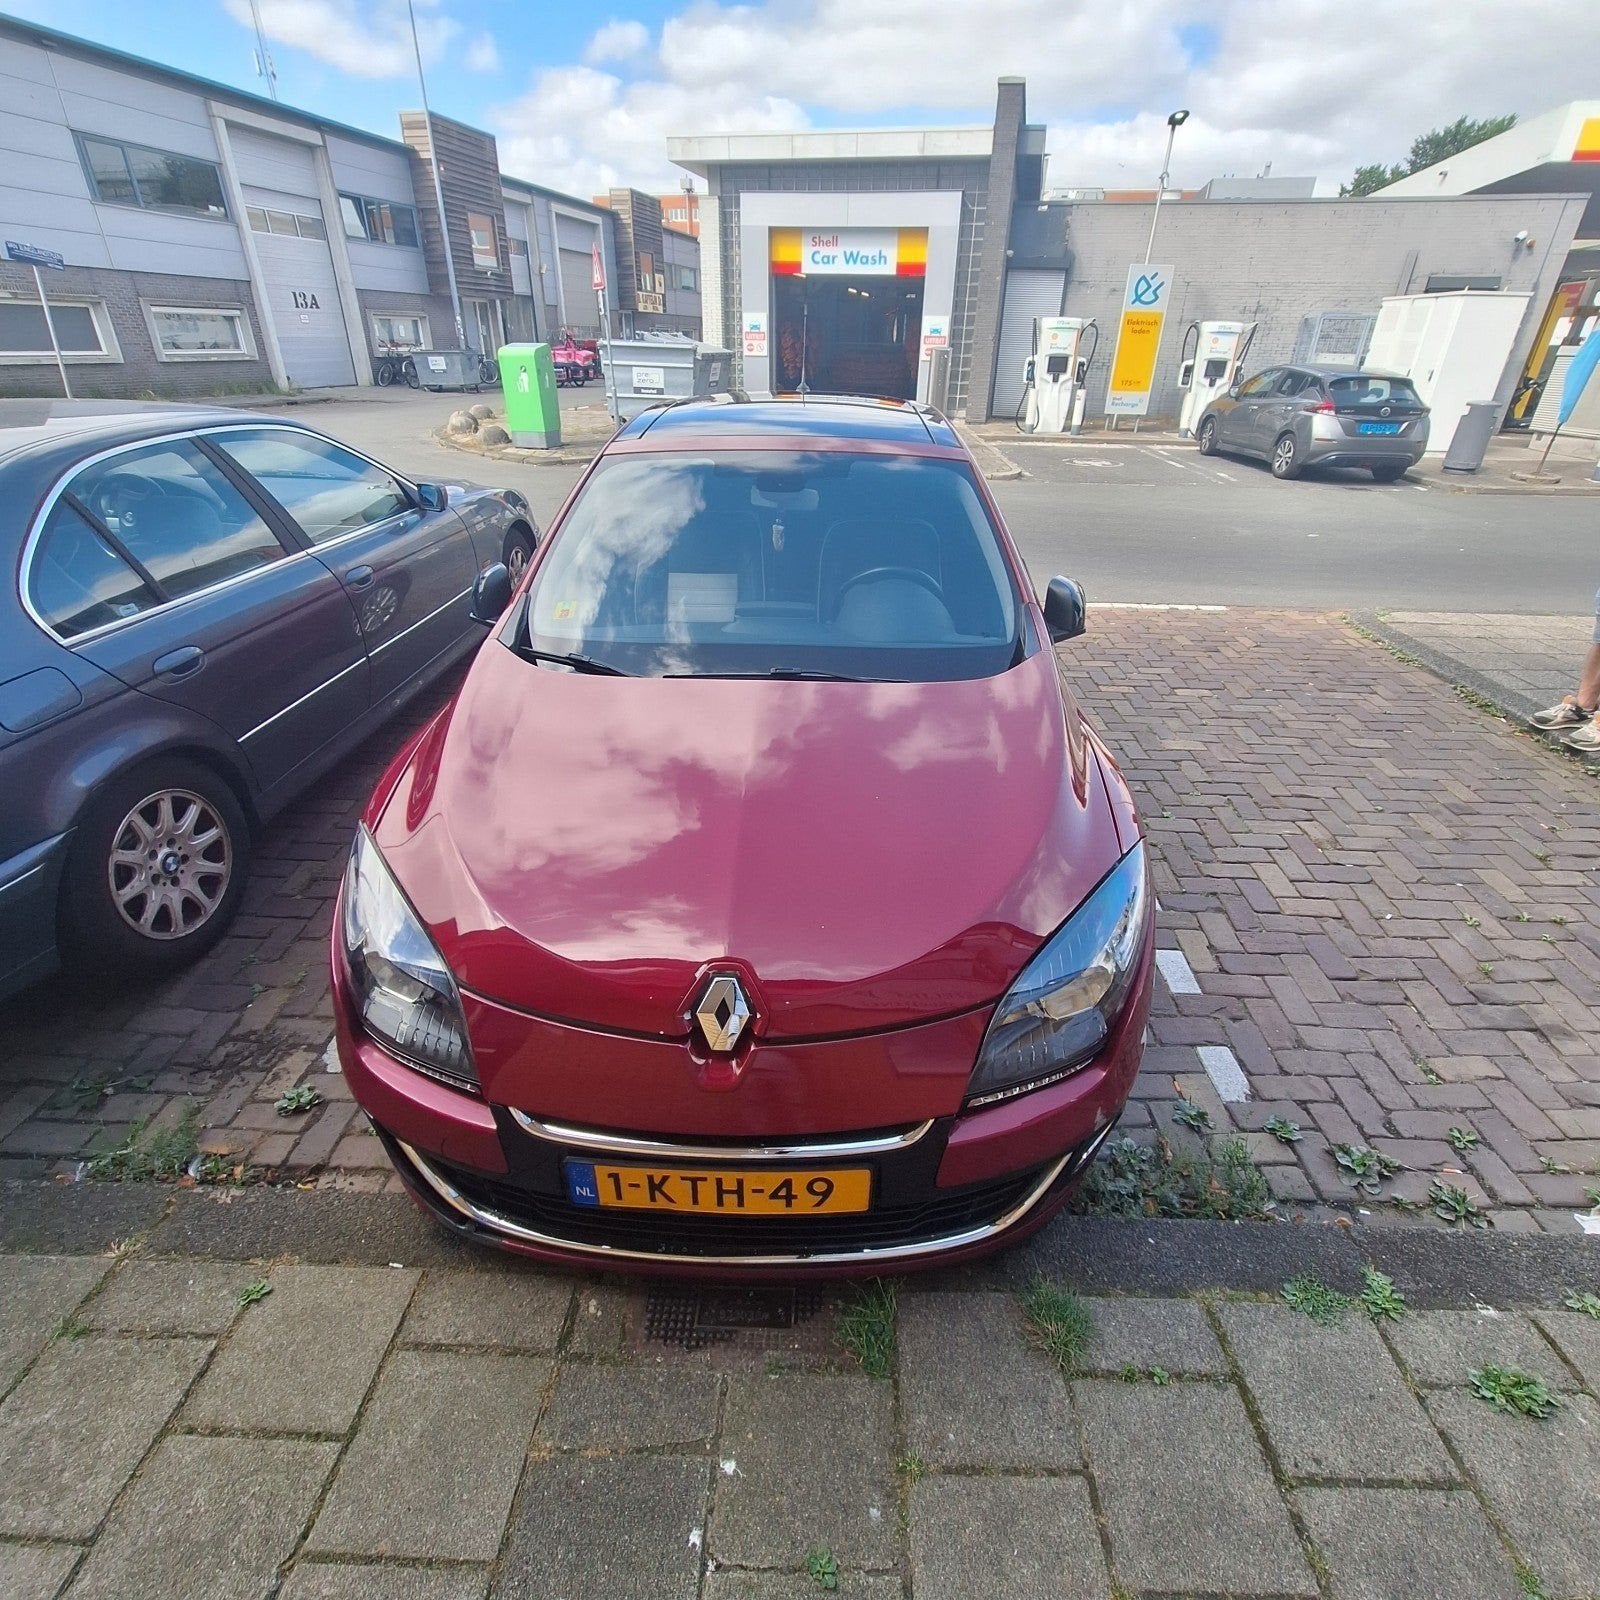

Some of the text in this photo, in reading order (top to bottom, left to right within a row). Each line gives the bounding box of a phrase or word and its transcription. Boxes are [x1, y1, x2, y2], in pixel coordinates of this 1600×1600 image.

[811, 235, 839, 247] Shell
[811, 249, 888, 265] Car Wash
[291, 291, 320, 309] 13A
[1126, 318, 1159, 326] Elektrisch
[1130, 327, 1151, 335] laden
[575, 1186, 596, 1198] NL
[607, 1172, 835, 1208] 1-KTH-49
